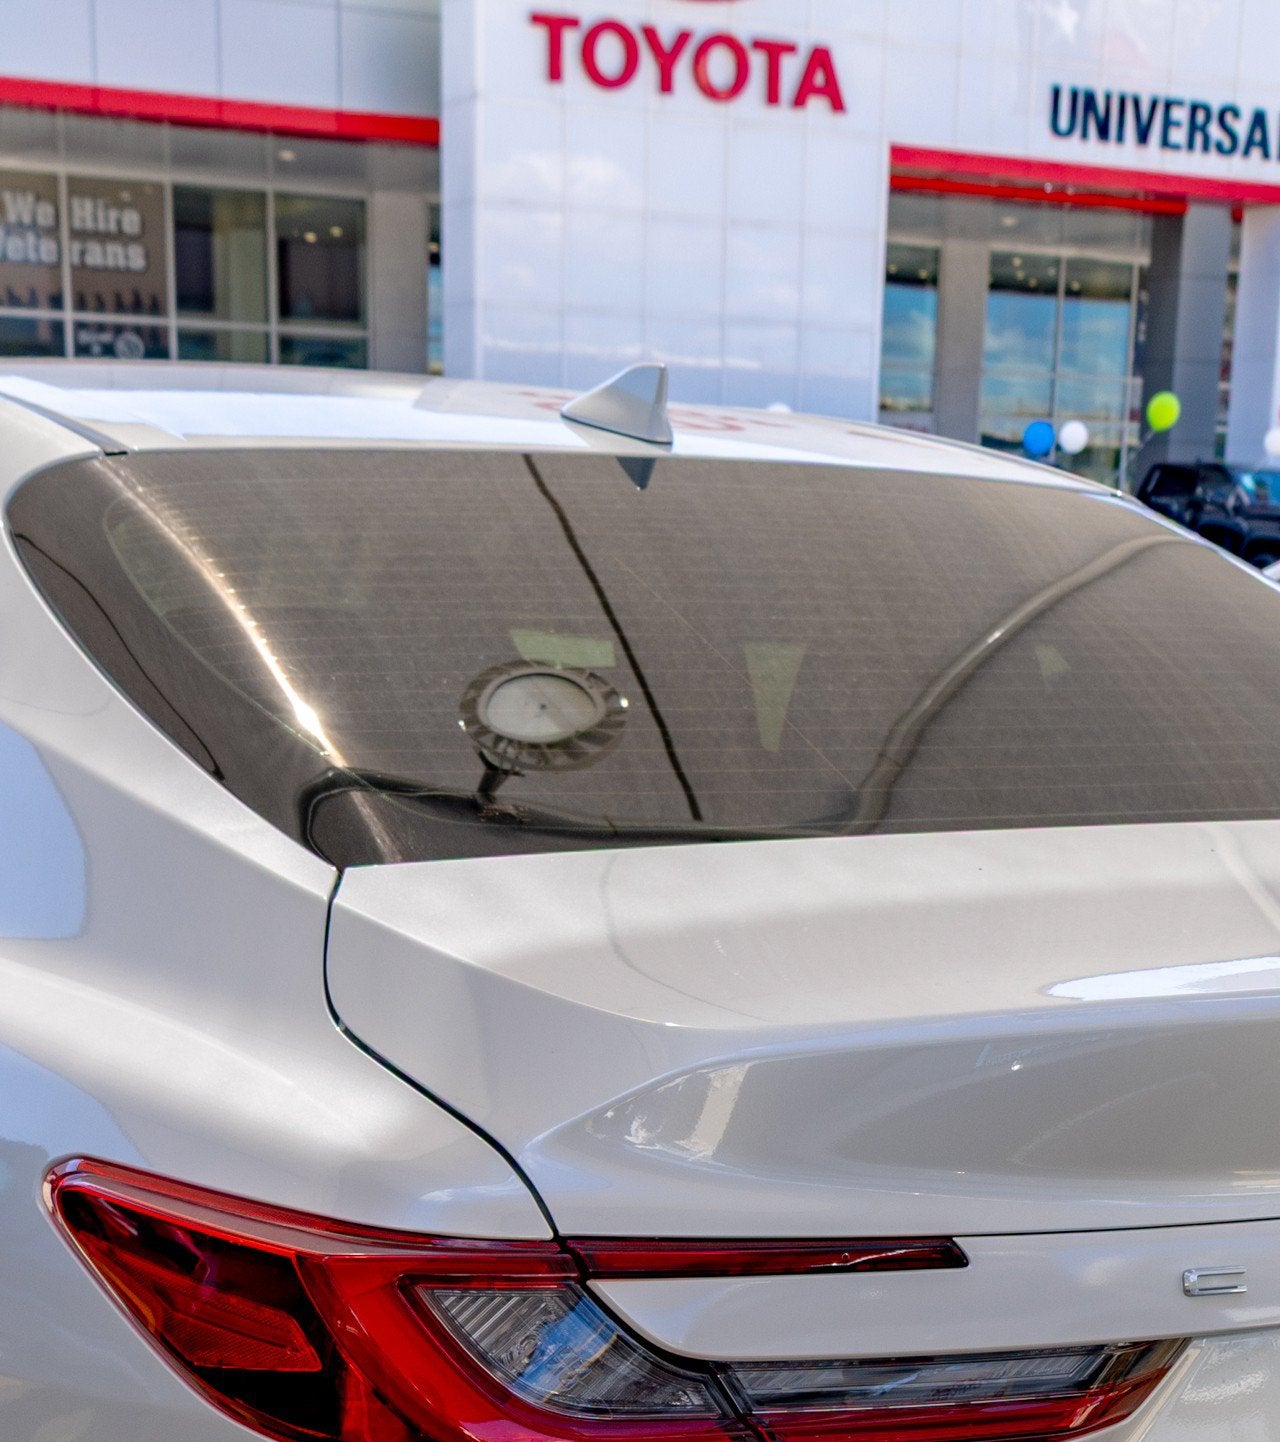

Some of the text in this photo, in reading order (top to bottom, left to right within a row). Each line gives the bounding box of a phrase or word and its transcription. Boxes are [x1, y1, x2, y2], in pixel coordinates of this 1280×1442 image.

[530, 12, 846, 114] TOYOTA
[1, 189, 142, 236] We Hire
